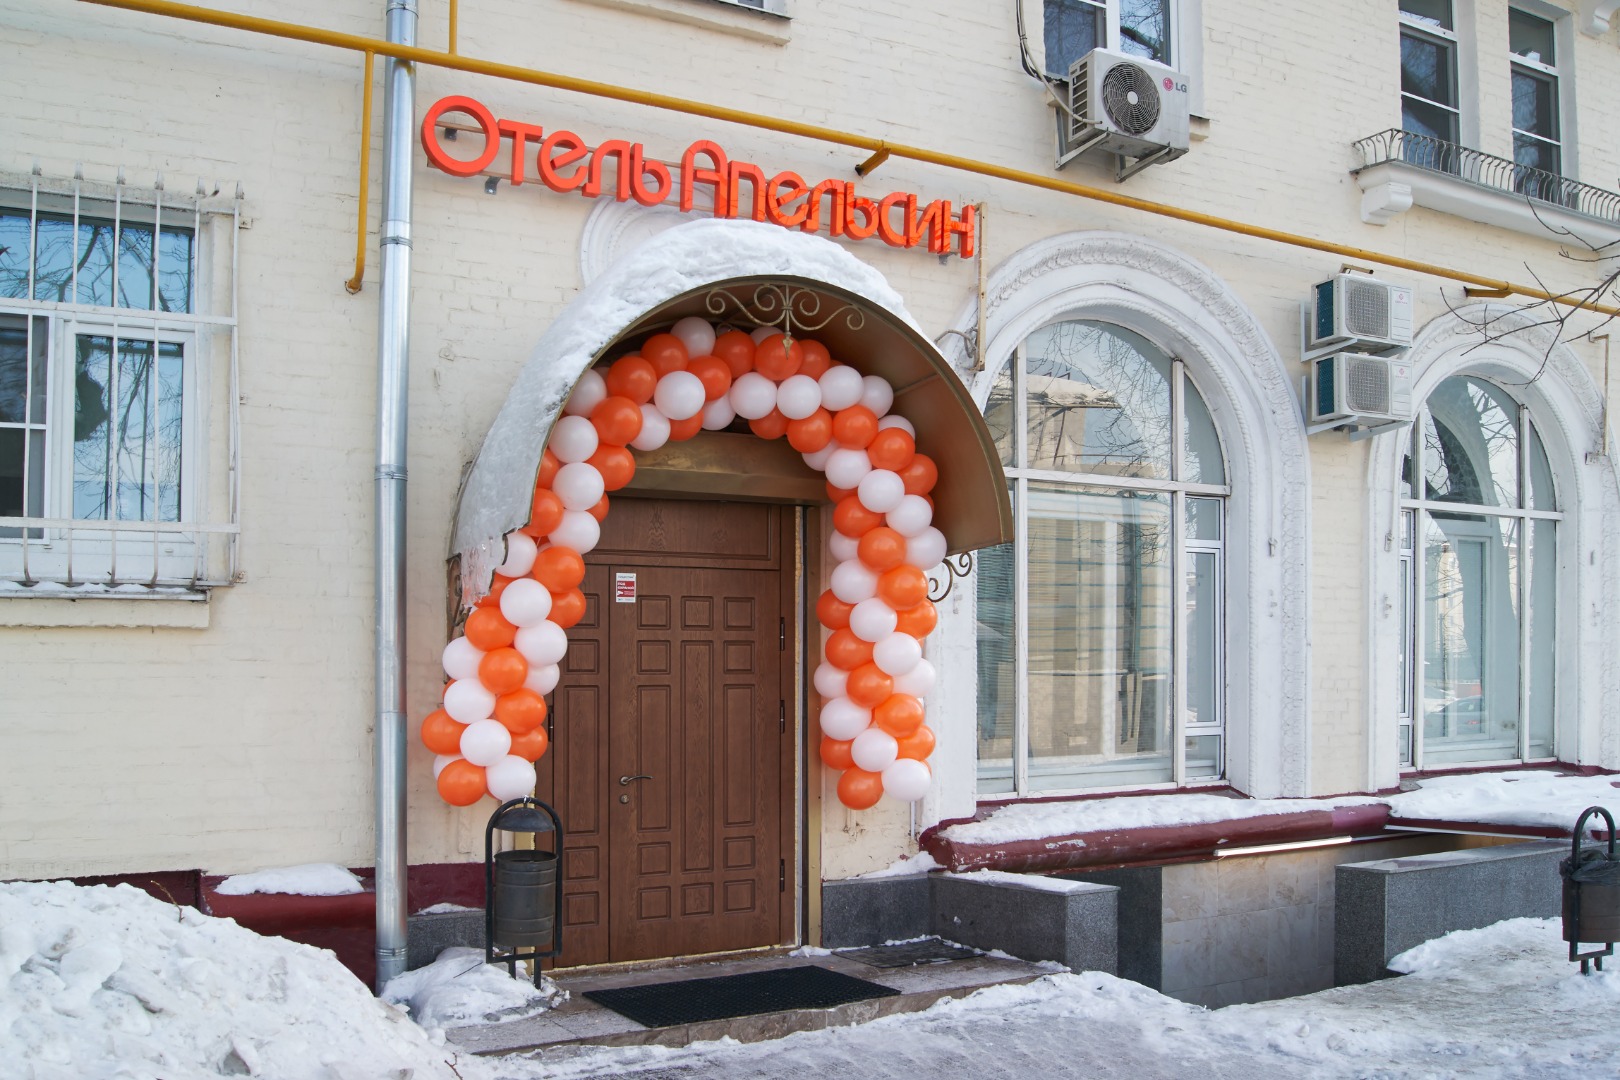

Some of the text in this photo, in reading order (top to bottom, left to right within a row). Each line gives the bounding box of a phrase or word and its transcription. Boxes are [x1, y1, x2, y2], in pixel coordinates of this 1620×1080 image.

[1175, 82, 1188, 94] LG
[421, 95, 978, 259] Отель Апельсин
